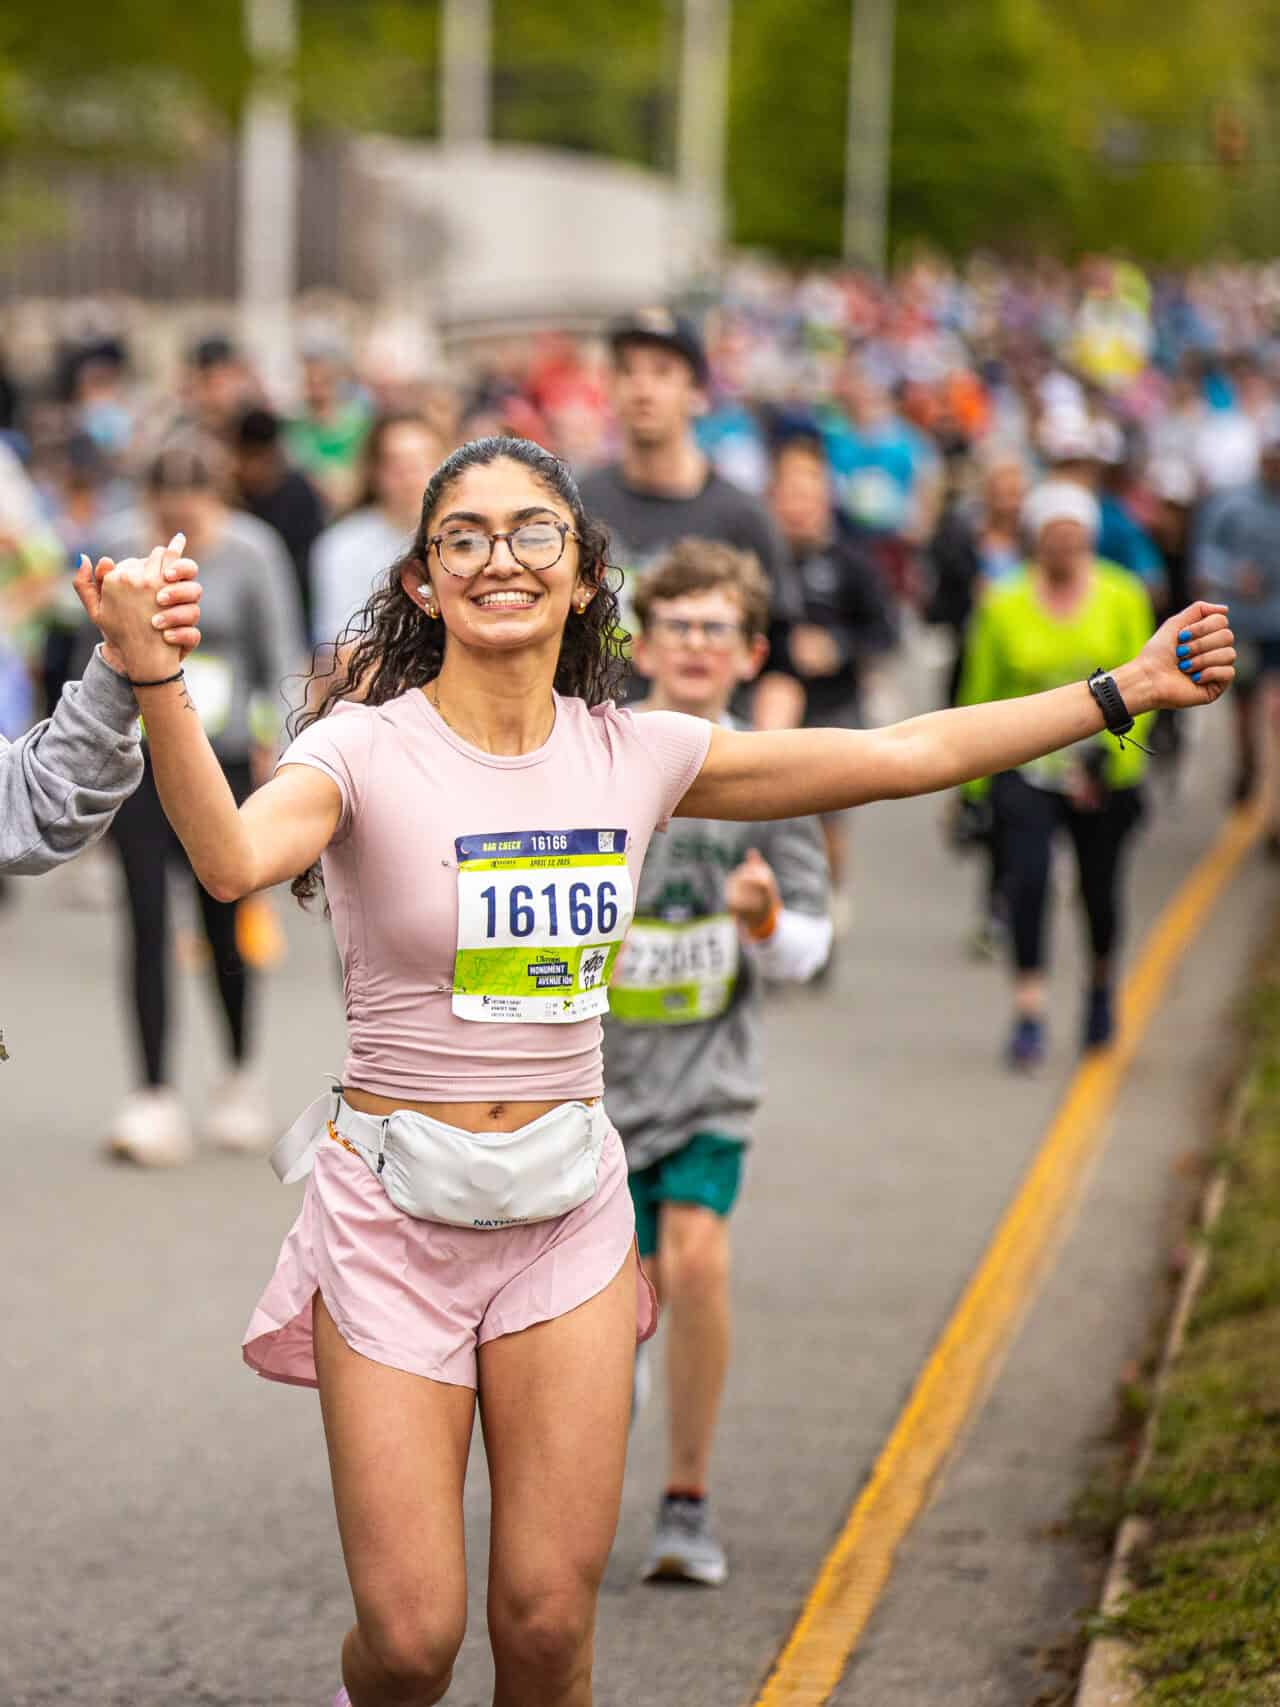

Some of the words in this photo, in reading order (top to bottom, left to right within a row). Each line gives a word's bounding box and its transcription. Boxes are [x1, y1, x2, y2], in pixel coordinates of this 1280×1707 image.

[499, 841, 522, 850] CHECK
[531, 835, 567, 850] 16166
[480, 881, 618, 937] 16166
[529, 964, 566, 975] MONUMENT
